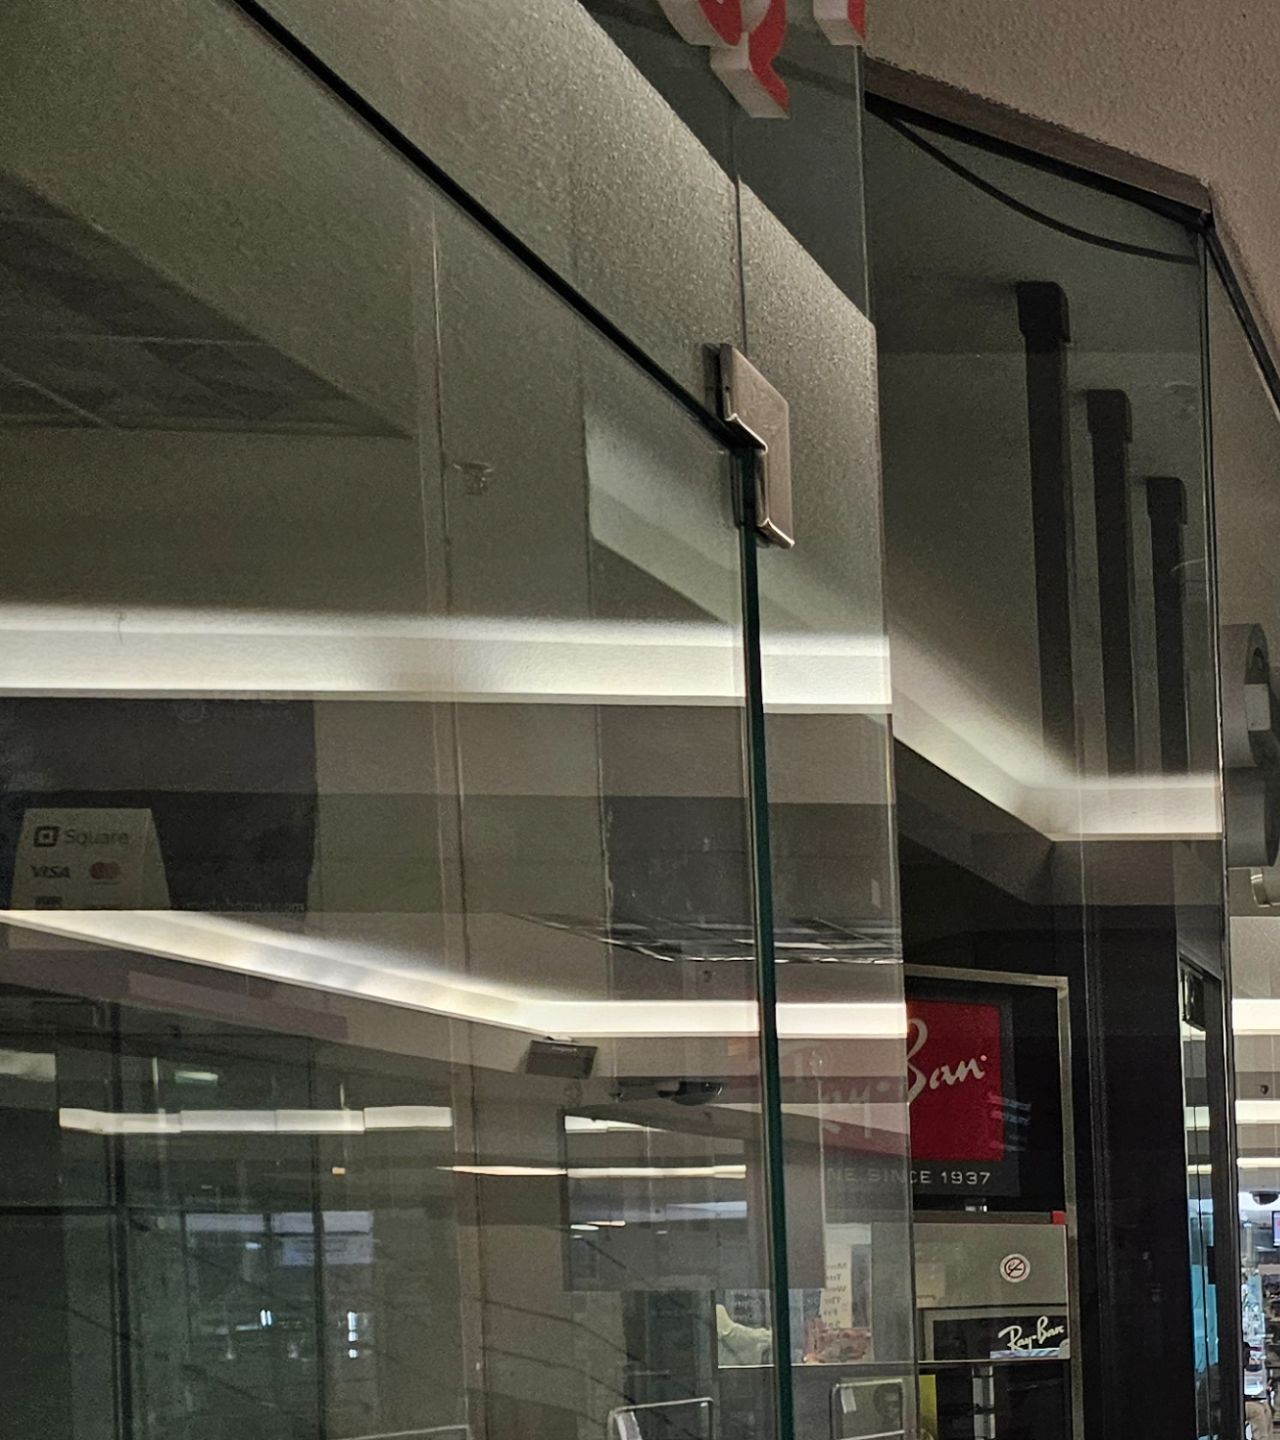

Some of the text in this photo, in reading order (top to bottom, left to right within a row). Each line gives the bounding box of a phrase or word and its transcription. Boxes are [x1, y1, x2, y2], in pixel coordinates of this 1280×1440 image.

[64, 829, 130, 846] Square
[31, 865, 71, 878] VISA
[940, 1171, 991, 1185] 1937
[998, 1315, 1064, 1352] Ray-Ban
